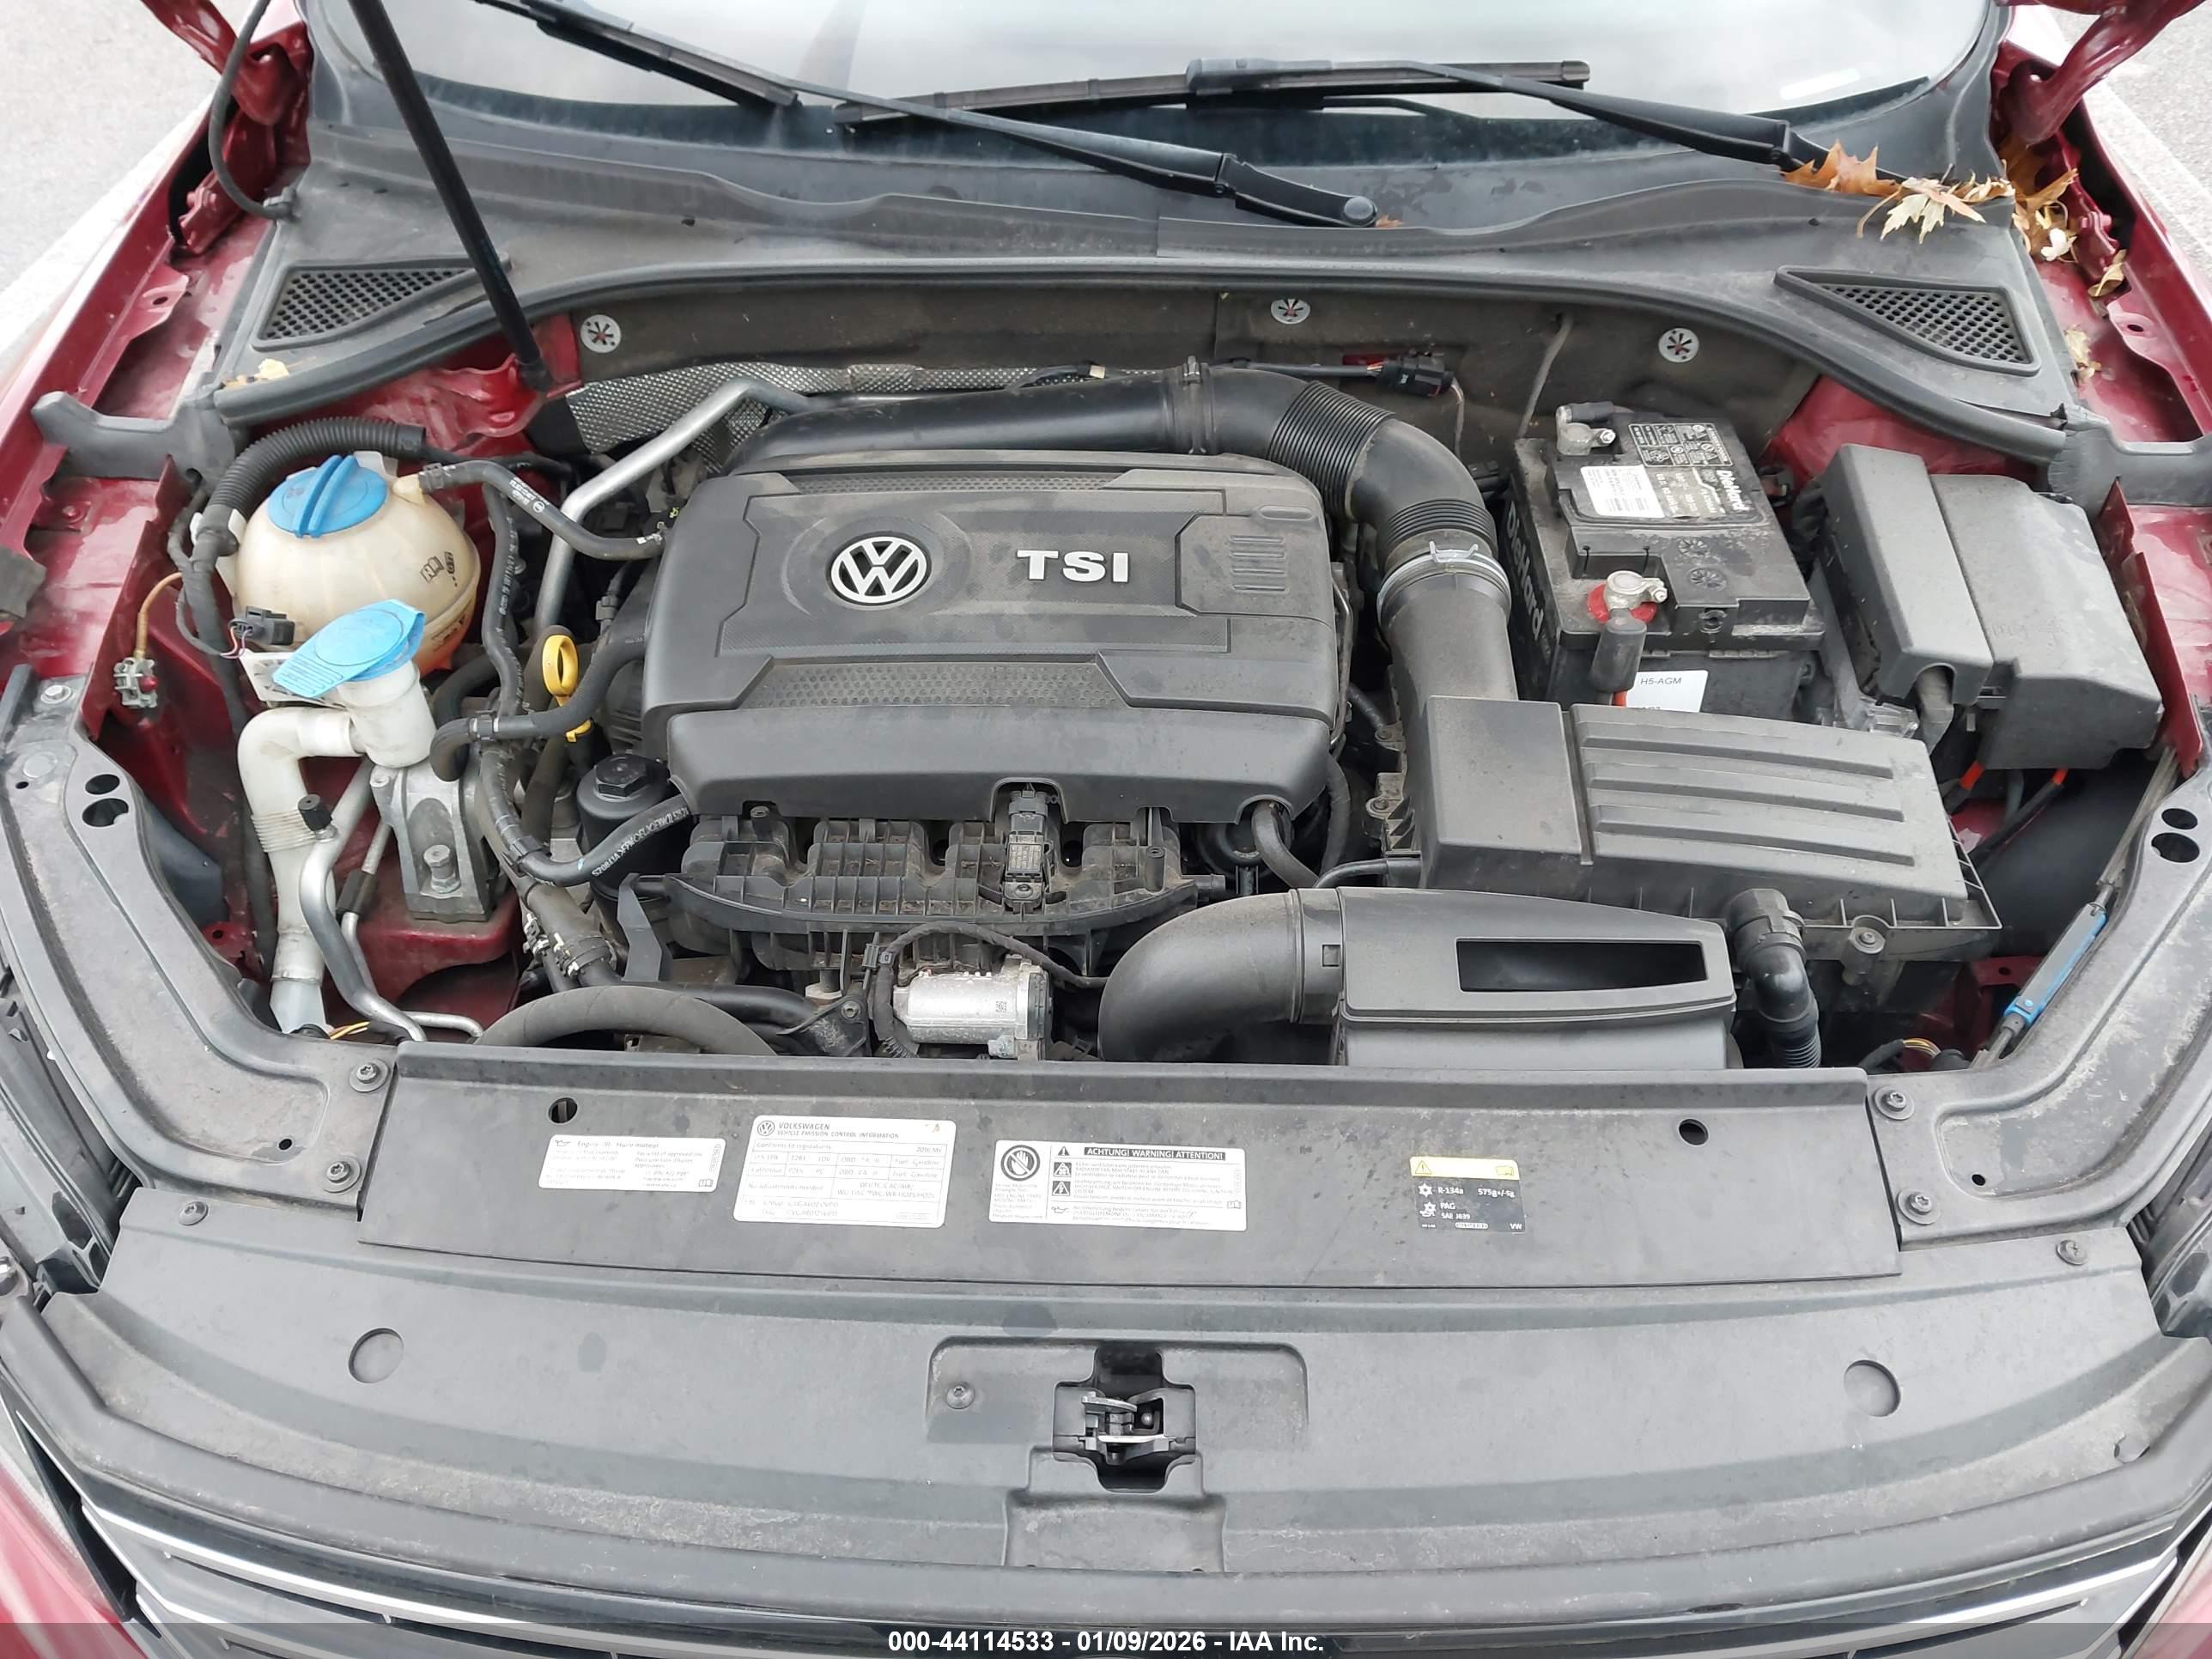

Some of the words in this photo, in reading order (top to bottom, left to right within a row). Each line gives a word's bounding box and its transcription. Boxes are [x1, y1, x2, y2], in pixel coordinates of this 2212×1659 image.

[1717, 470, 1750, 511] DieHard
[1017, 550, 1128, 583] TSI
[1640, 677, 1682, 685] H5-AGM
[779, 1122, 830, 1131] VOLKSWAGEN
[1086, 1147, 1130, 1158] ACHTUNG!
[1132, 1150, 1174, 1159] WARNING!
[1176, 1152, 1224, 1160] ATTENTION!
